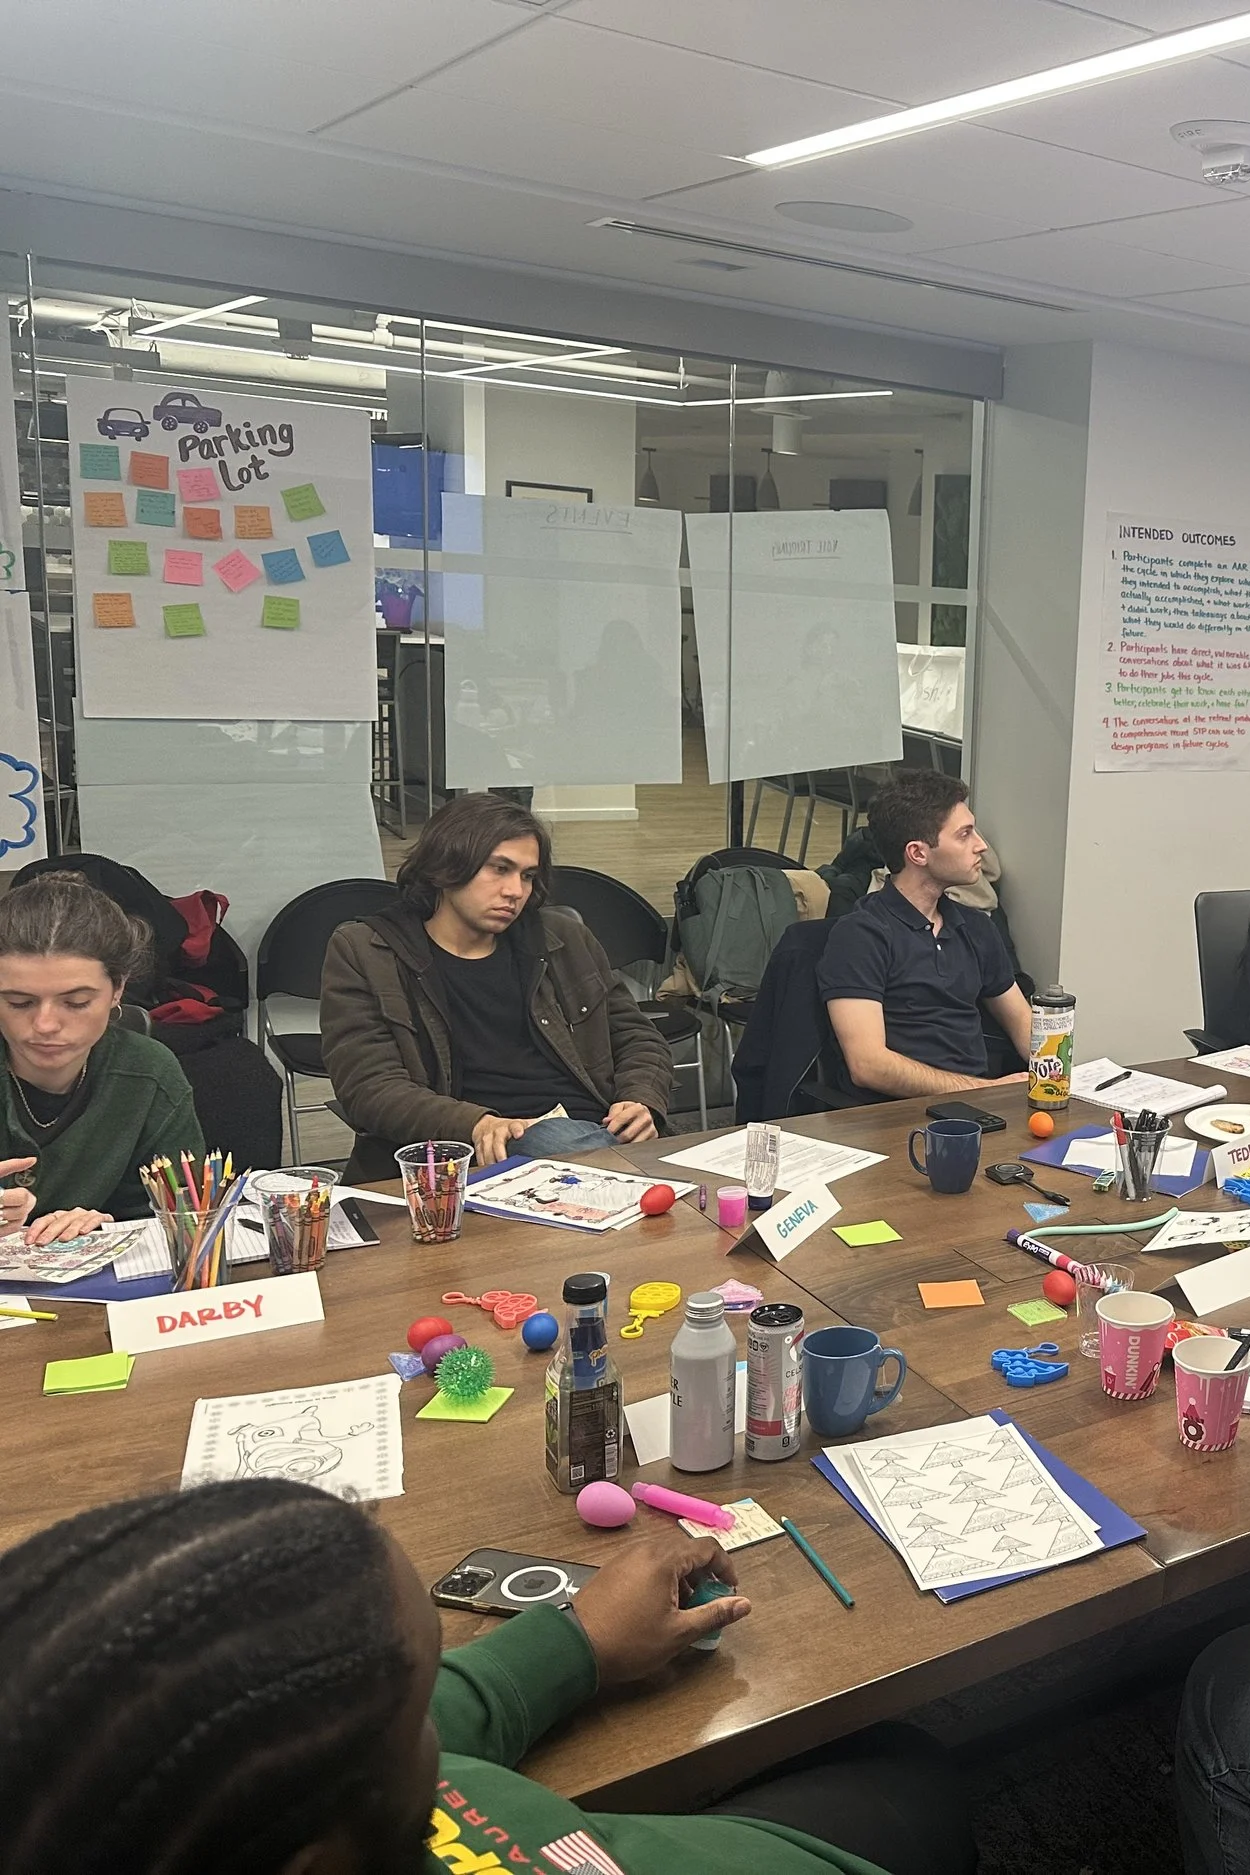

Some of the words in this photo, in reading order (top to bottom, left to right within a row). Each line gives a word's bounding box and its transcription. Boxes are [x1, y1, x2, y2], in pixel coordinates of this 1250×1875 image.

[178, 421, 294, 462] Parking
[218, 454, 270, 492] Lot
[1119, 525, 1174, 541] INTENDED
[1181, 532, 1236, 546] OUTCOMES
[1123, 550, 1174, 568] Participants
[1178, 560, 1213, 571] complete
[1232, 562, 1249, 571] AAR
[1121, 564, 1135, 573] the
[1137, 566, 1158, 577] cycle
[1171, 570, 1192, 580] which
[1193, 572, 1210, 585] they
[1210, 575, 1235, 586] explore
[1121, 577, 1137, 590] they
[1139, 580, 1171, 590] intended
[1173, 582, 1181, 590] to
[1224, 588, 1243, 597] what
[1121, 590, 1152, 606] actually
[1213, 598, 1231, 607] what
[1191, 609, 1228, 622] takeaways
[1144, 617, 1161, 631] they
[1163, 621, 1184, 629] would
[1186, 622, 1196, 630] do
[1198, 623, 1233, 635] differently
[1120, 641, 1168, 656] Participants
[1171, 644, 1188, 655] have
[1214, 648, 1250, 660] vulnerable
[1119, 656, 1169, 666] conversations
[1172, 657, 1193, 667] about
[1196, 660, 1213, 669] what
[1217, 661, 1224, 669] it
[1118, 668, 1128, 678] to
[1129, 669, 1139, 678] do
[1140, 669, 1158, 679] their
[1159, 671, 1175, 682] jobs
[1178, 671, 1191, 680] this
[1117, 682, 1167, 697] Participants
[1171, 686, 1182, 699] get
[1185, 687, 1194, 695] to
[1197, 686, 1216, 696] know
[1220, 687, 1235, 697] each
[1138, 698, 1171, 709] celebrate
[1113, 717, 1129, 728] The
[1183, 715, 1191, 723] at
[1194, 715, 1206, 723] the
[1120, 729, 1167, 739] comprehensive
[1111, 742, 1134, 754] design
[1135, 742, 1169, 754] programs
[1181, 740, 1203, 750] future
[776, 1199, 819, 1239] GENEVA
[156, 1294, 263, 1333] DARBY
